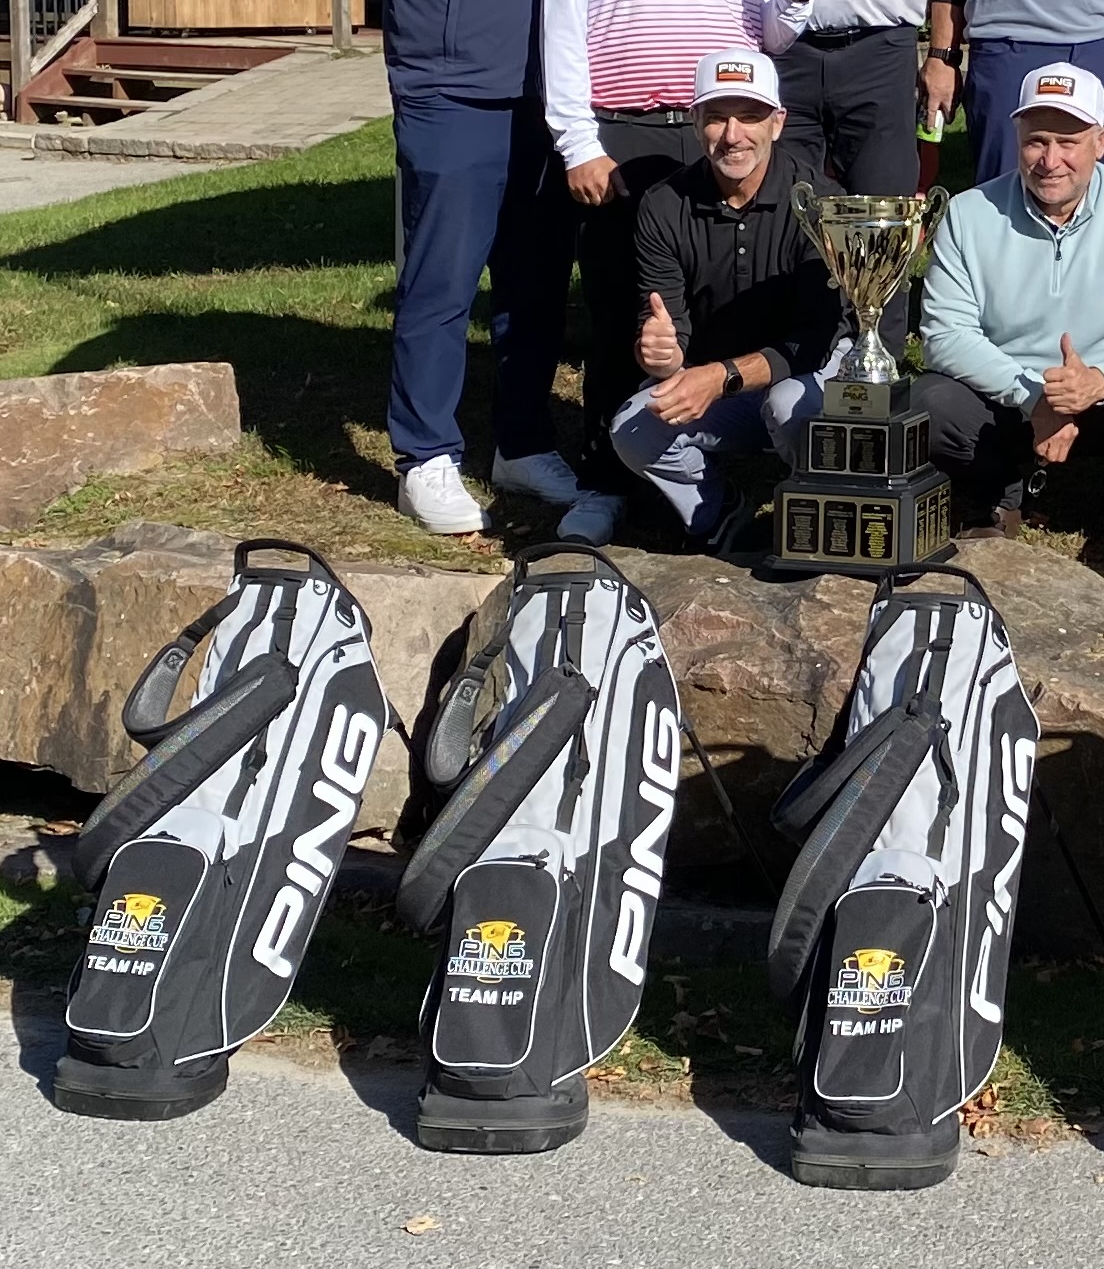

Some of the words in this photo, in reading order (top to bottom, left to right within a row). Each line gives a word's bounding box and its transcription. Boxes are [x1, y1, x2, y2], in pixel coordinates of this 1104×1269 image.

[718, 63, 752, 74] PING
[1040, 77, 1073, 88] PING
[842, 391, 869, 400] PING
[252, 703, 379, 974] PING
[609, 699, 682, 986] PING
[970, 732, 1037, 1024] PING
[101, 909, 166, 933] PING
[89, 928, 149, 947] CHALLENGE
[147, 934, 169, 948] CUP
[459, 938, 526, 961] PING
[87, 955, 131, 973] TEAM
[131, 960, 155, 976] HP
[447, 959, 510, 975] CHALLENGE
[511, 962, 534, 976] CUP
[838, 968, 905, 990] PING
[448, 987, 498, 1005] TEAM
[501, 990, 524, 1006] HP
[827, 990, 890, 1005] CHALLENGE
[890, 990, 912, 1004] CUP
[829, 1020, 877, 1036] TEAM
[879, 1018, 903, 1034] HP
